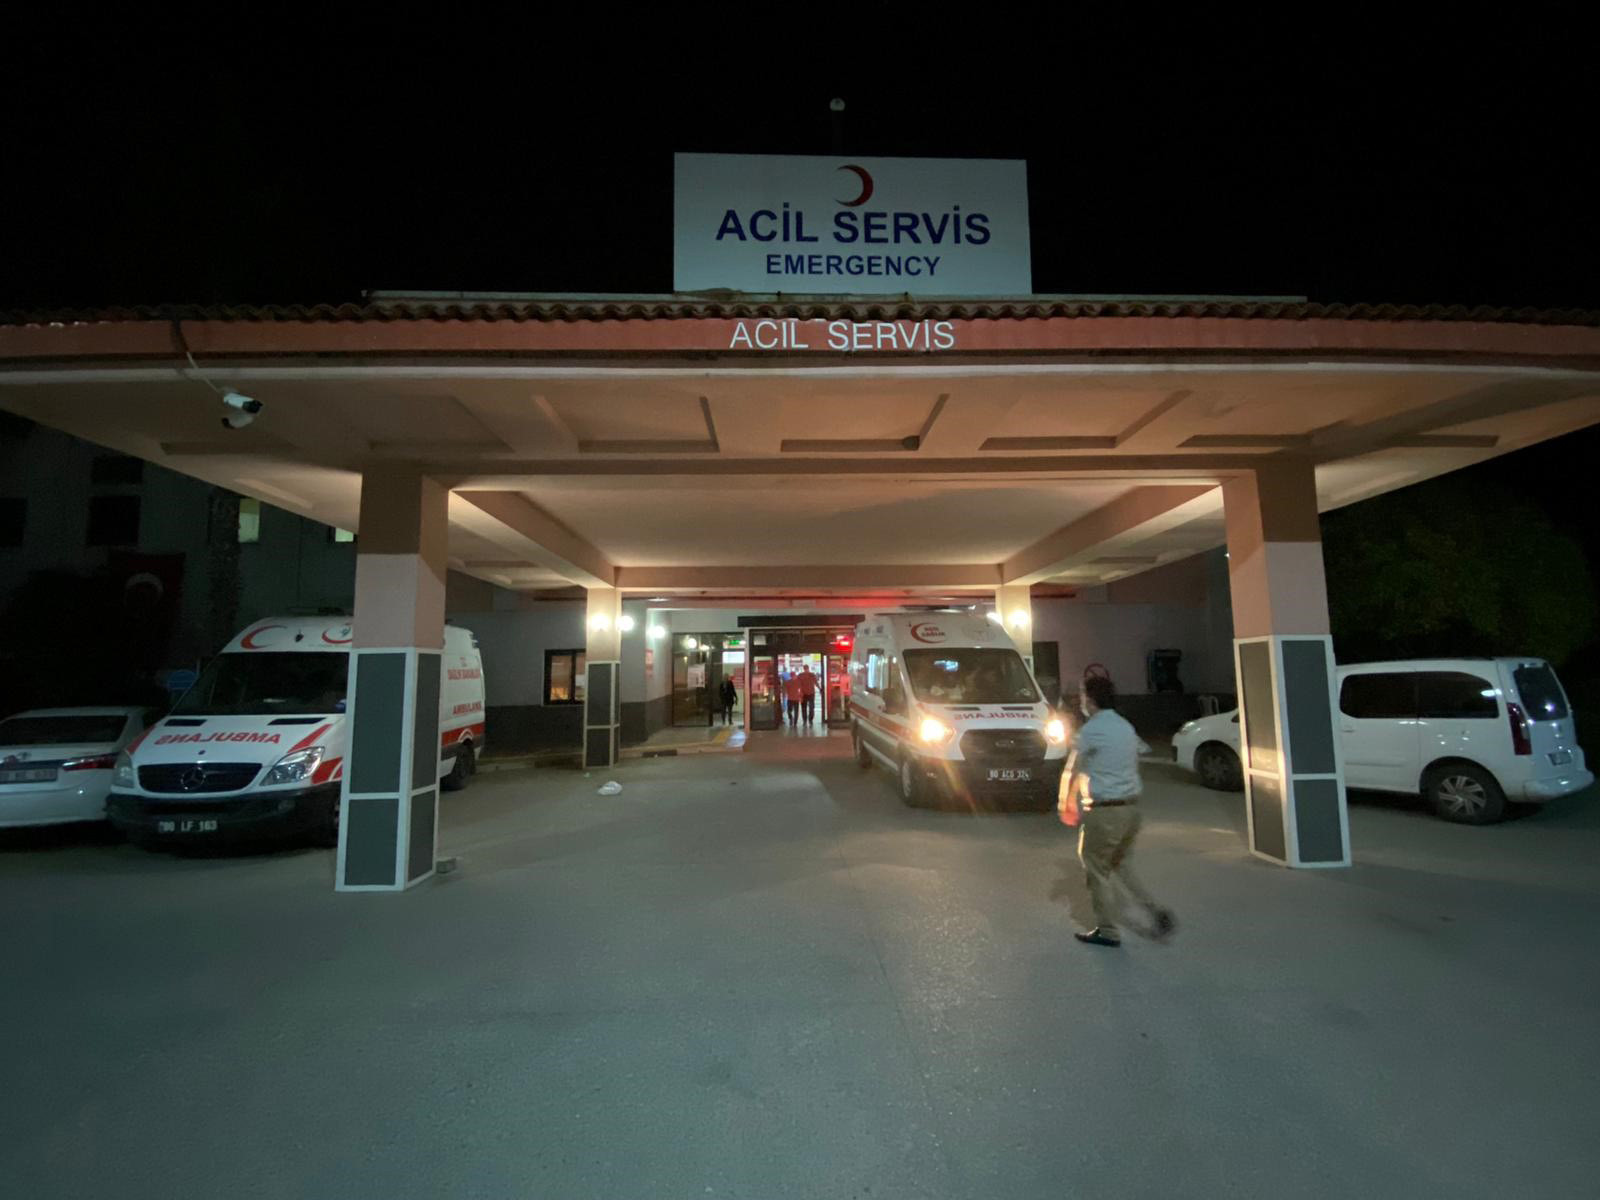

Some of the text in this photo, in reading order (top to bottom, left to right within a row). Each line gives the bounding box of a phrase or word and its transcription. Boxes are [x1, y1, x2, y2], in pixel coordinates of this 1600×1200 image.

[715, 202, 991, 245] ACİL SERVİS
[766, 254, 941, 276] EMERGENCY
